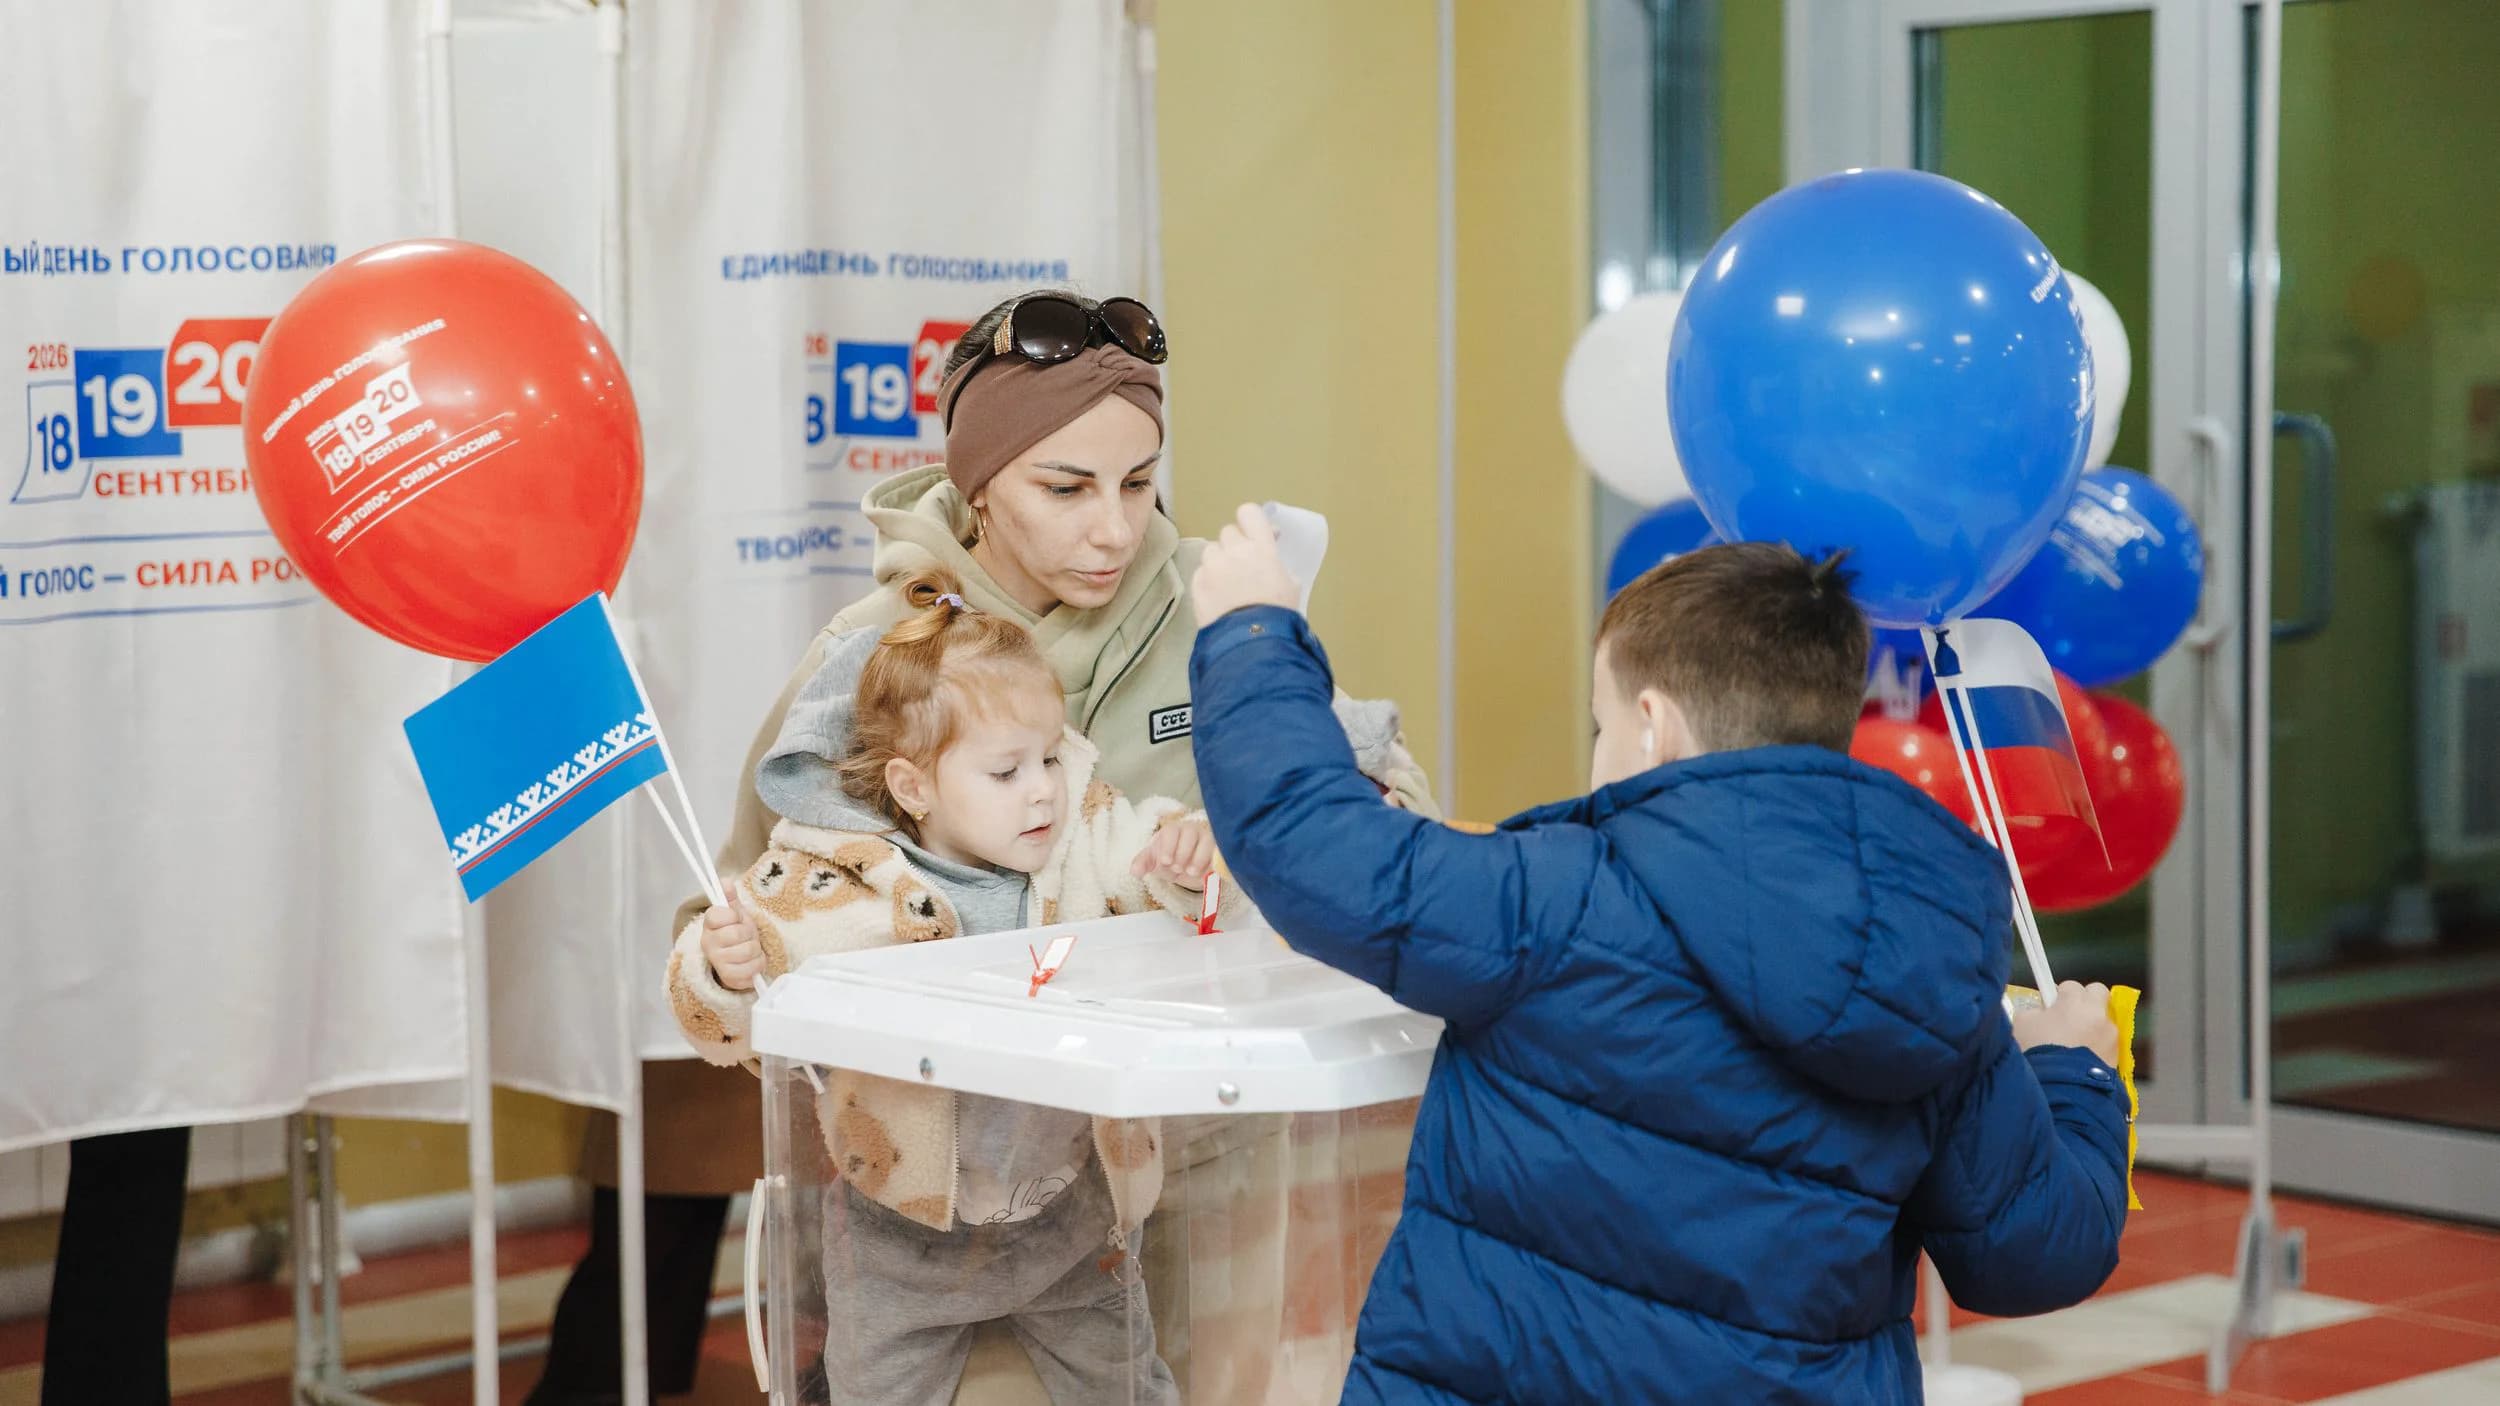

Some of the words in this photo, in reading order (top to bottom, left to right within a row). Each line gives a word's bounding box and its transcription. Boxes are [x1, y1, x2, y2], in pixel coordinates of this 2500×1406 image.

[44, 247, 111, 275] ДЕНЬ
[889, 252, 1068, 281] ГОЛОСОВАНИЯ
[28, 344, 68, 370] 2026
[841, 362, 909, 422] 19
[917, 339, 953, 392] 2
[37, 414, 73, 473] 18
[83, 374, 158, 437] 19
[324, 444, 356, 476] 18
[345, 413, 375, 443] 19
[371, 379, 409, 414] 20
[351, 490, 392, 524] ГОЛОС
[399, 462, 439, 489] СИЛА
[20, 565, 94, 597] ГОЛОС
[136, 559, 238, 587] СИЛА
